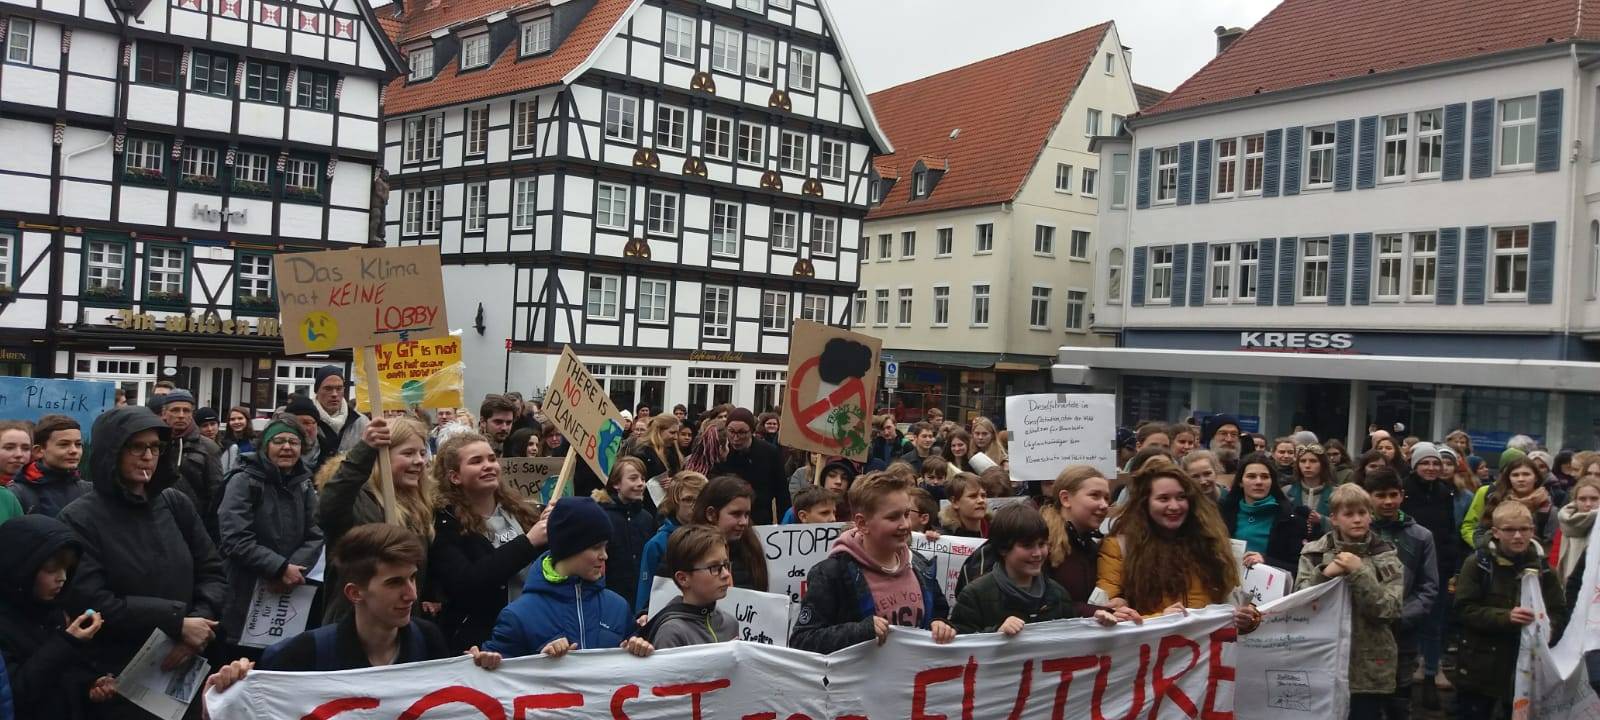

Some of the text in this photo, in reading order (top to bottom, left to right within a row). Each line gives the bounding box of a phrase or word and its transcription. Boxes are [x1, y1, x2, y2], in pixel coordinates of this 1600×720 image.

[192, 203, 248, 225] Hotel
[285, 257, 419, 283] Das Klima
[328, 282, 386, 307] KEINE
[115, 308, 281, 337] Im wilden M
[375, 305, 438, 331] LOBBY
[421, 346, 431, 356] is
[435, 342, 457, 355] not
[1240, 332, 1353, 349] KRESS
[563, 378, 582, 407] NO
[566, 352, 609, 416] THERE IS
[26, 385, 89, 412] Plastik
[546, 389, 597, 460] PLANET B
[522, 462, 549, 475] save
[766, 527, 841, 560] STOPP
[787, 565, 806, 578] das
[262, 606, 272, 618] für
[736, 602, 758, 624] Wir
